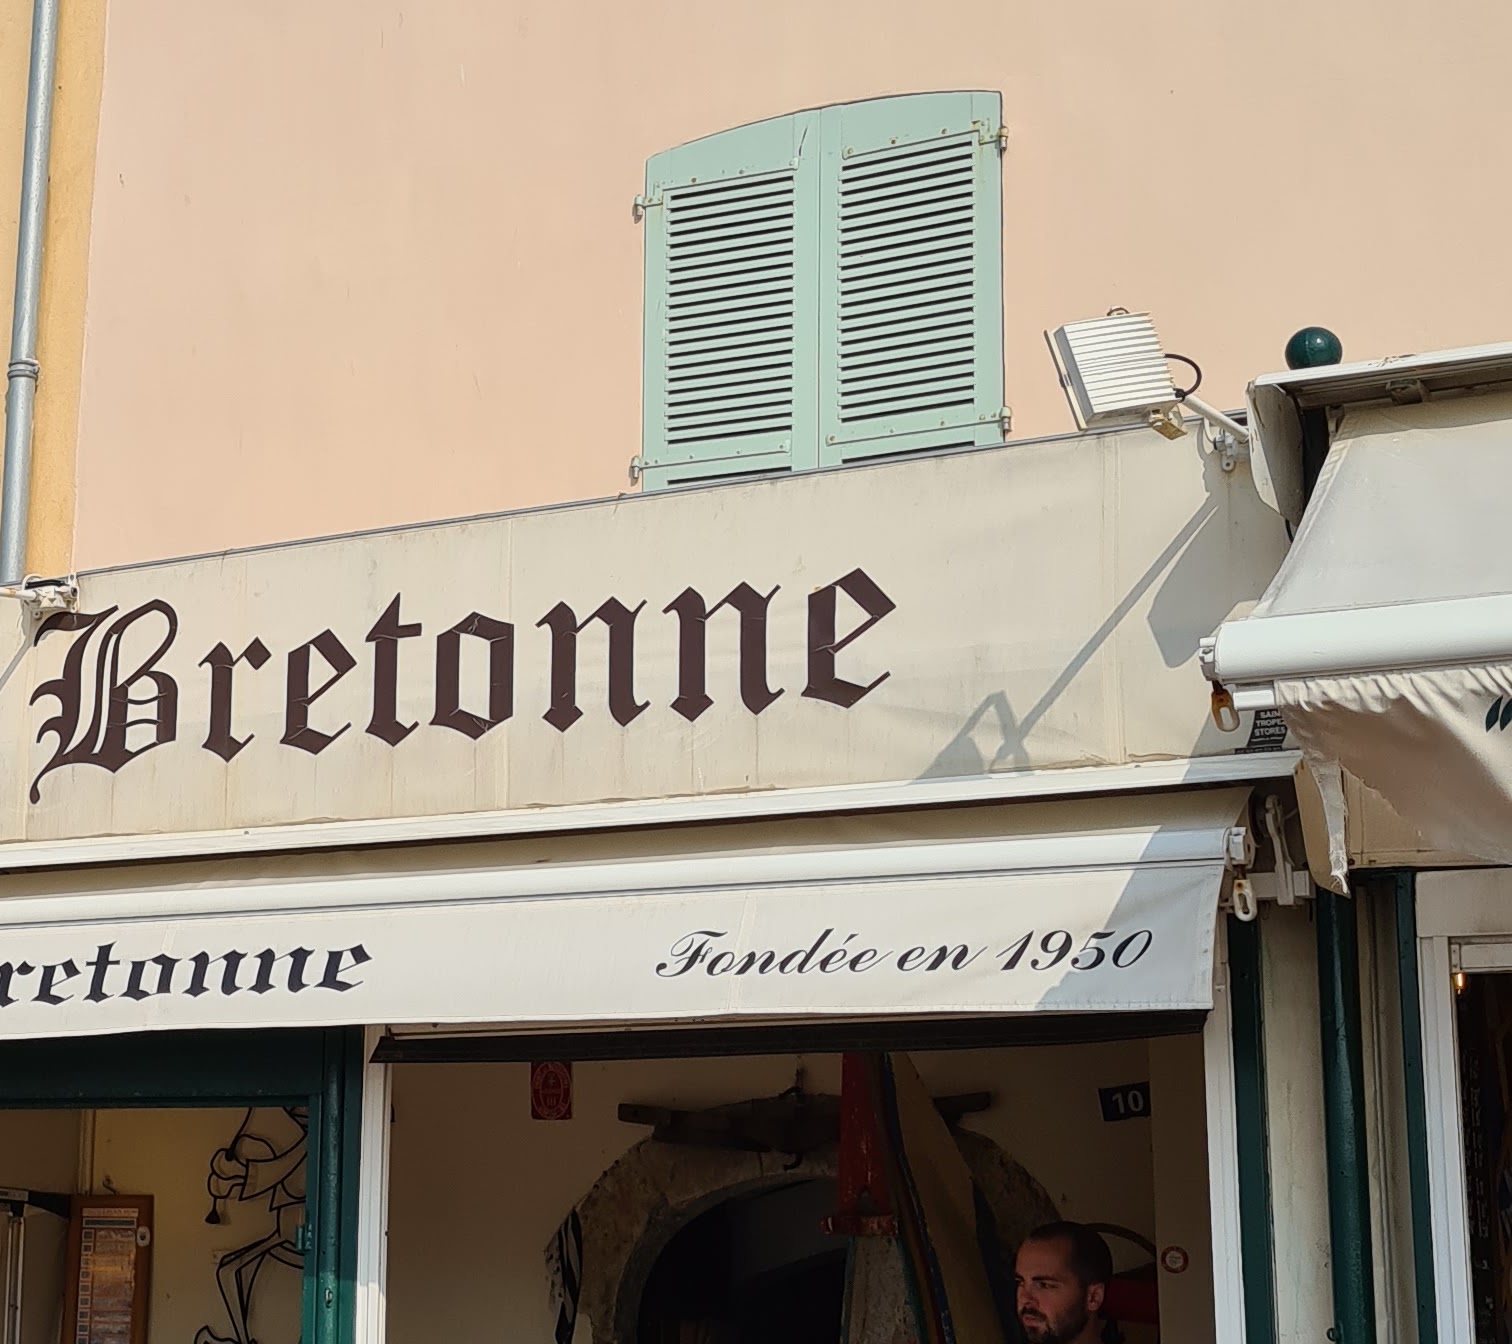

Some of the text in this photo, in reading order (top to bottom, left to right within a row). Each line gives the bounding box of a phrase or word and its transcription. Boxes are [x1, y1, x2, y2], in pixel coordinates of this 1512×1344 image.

[29, 567, 891, 804] Bretonne
[655, 928, 1153, 981] Fondée en 1950
[1112, 1090, 1144, 1114] 10
